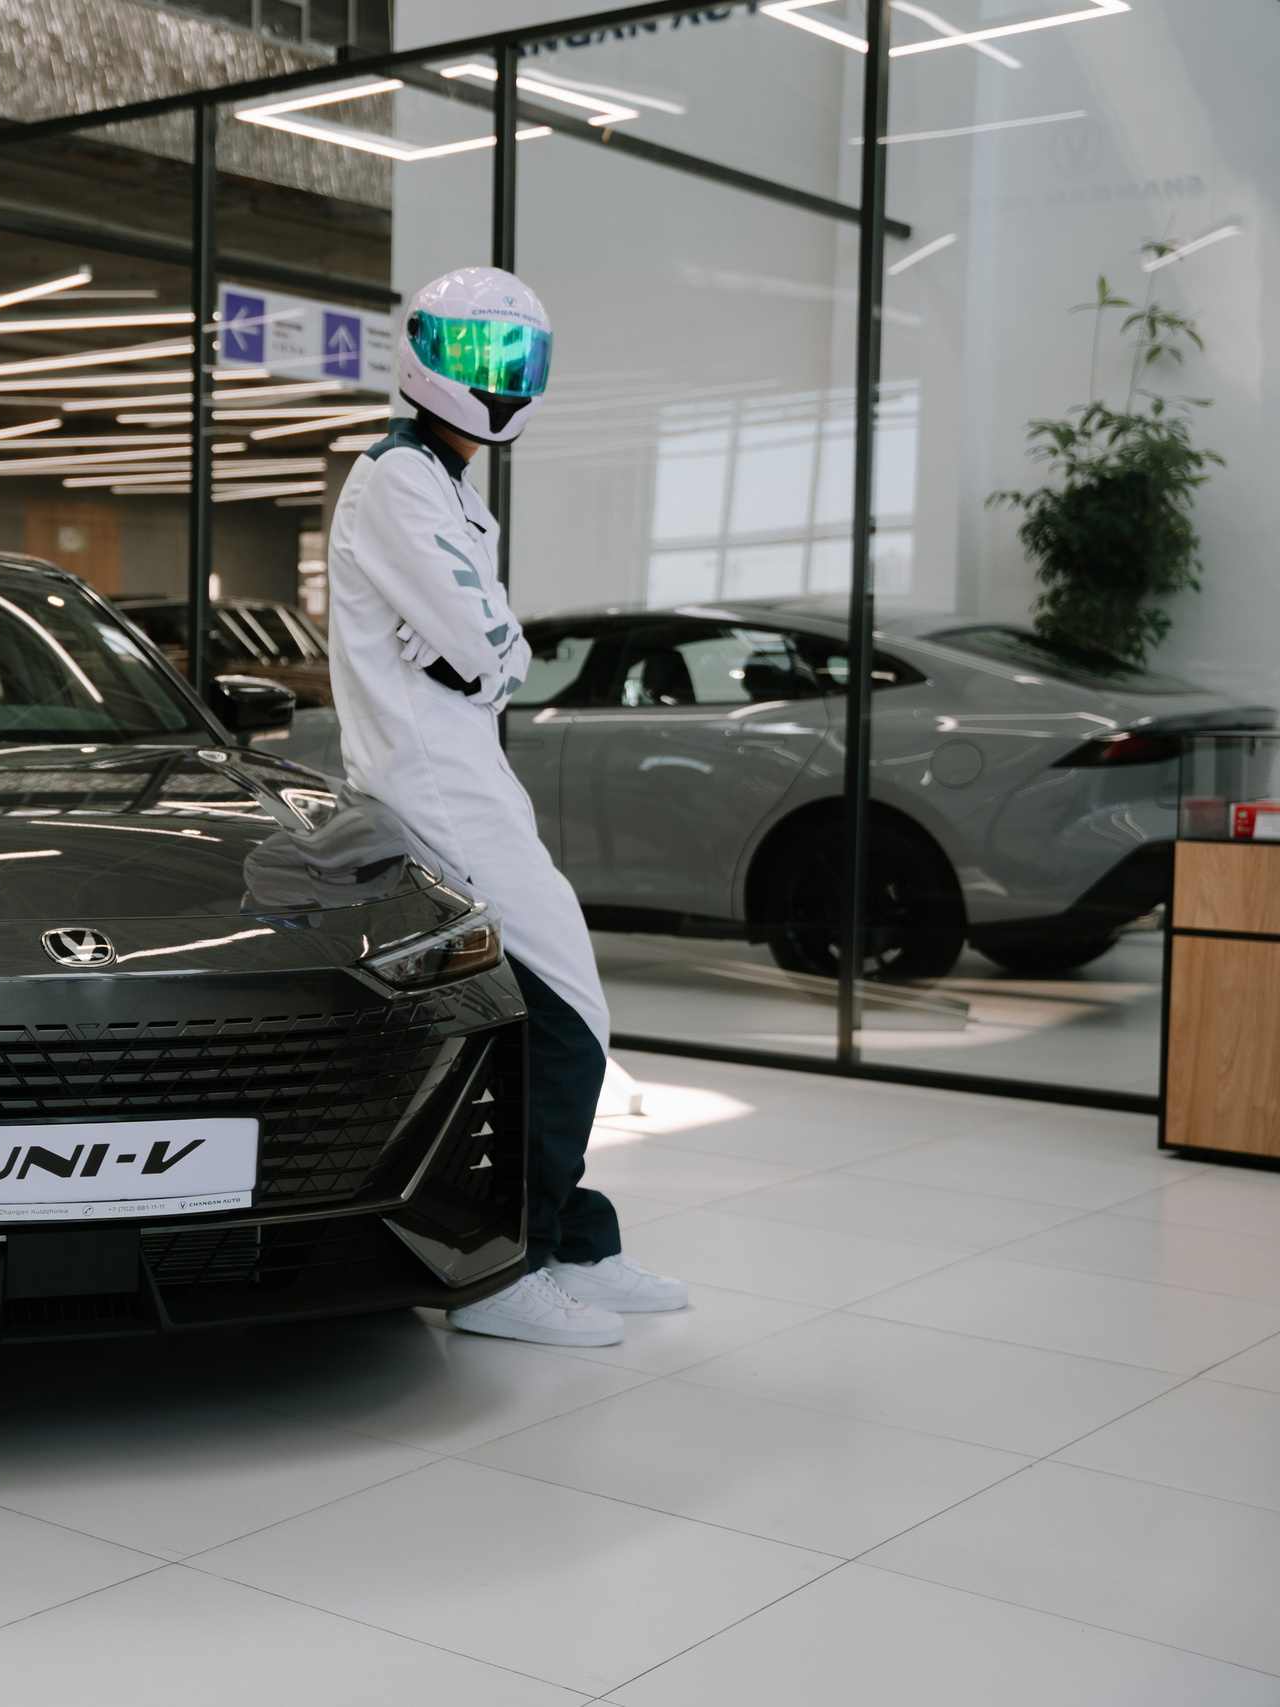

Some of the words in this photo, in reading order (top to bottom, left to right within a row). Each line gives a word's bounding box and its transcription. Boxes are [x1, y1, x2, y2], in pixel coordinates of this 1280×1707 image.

[471, 309, 521, 318] CHANGAN
[522, 314, 541, 326] AUTO
[188, 1199, 222, 1207] CHANGAN
[118, 1205, 136, 1213] (702)
